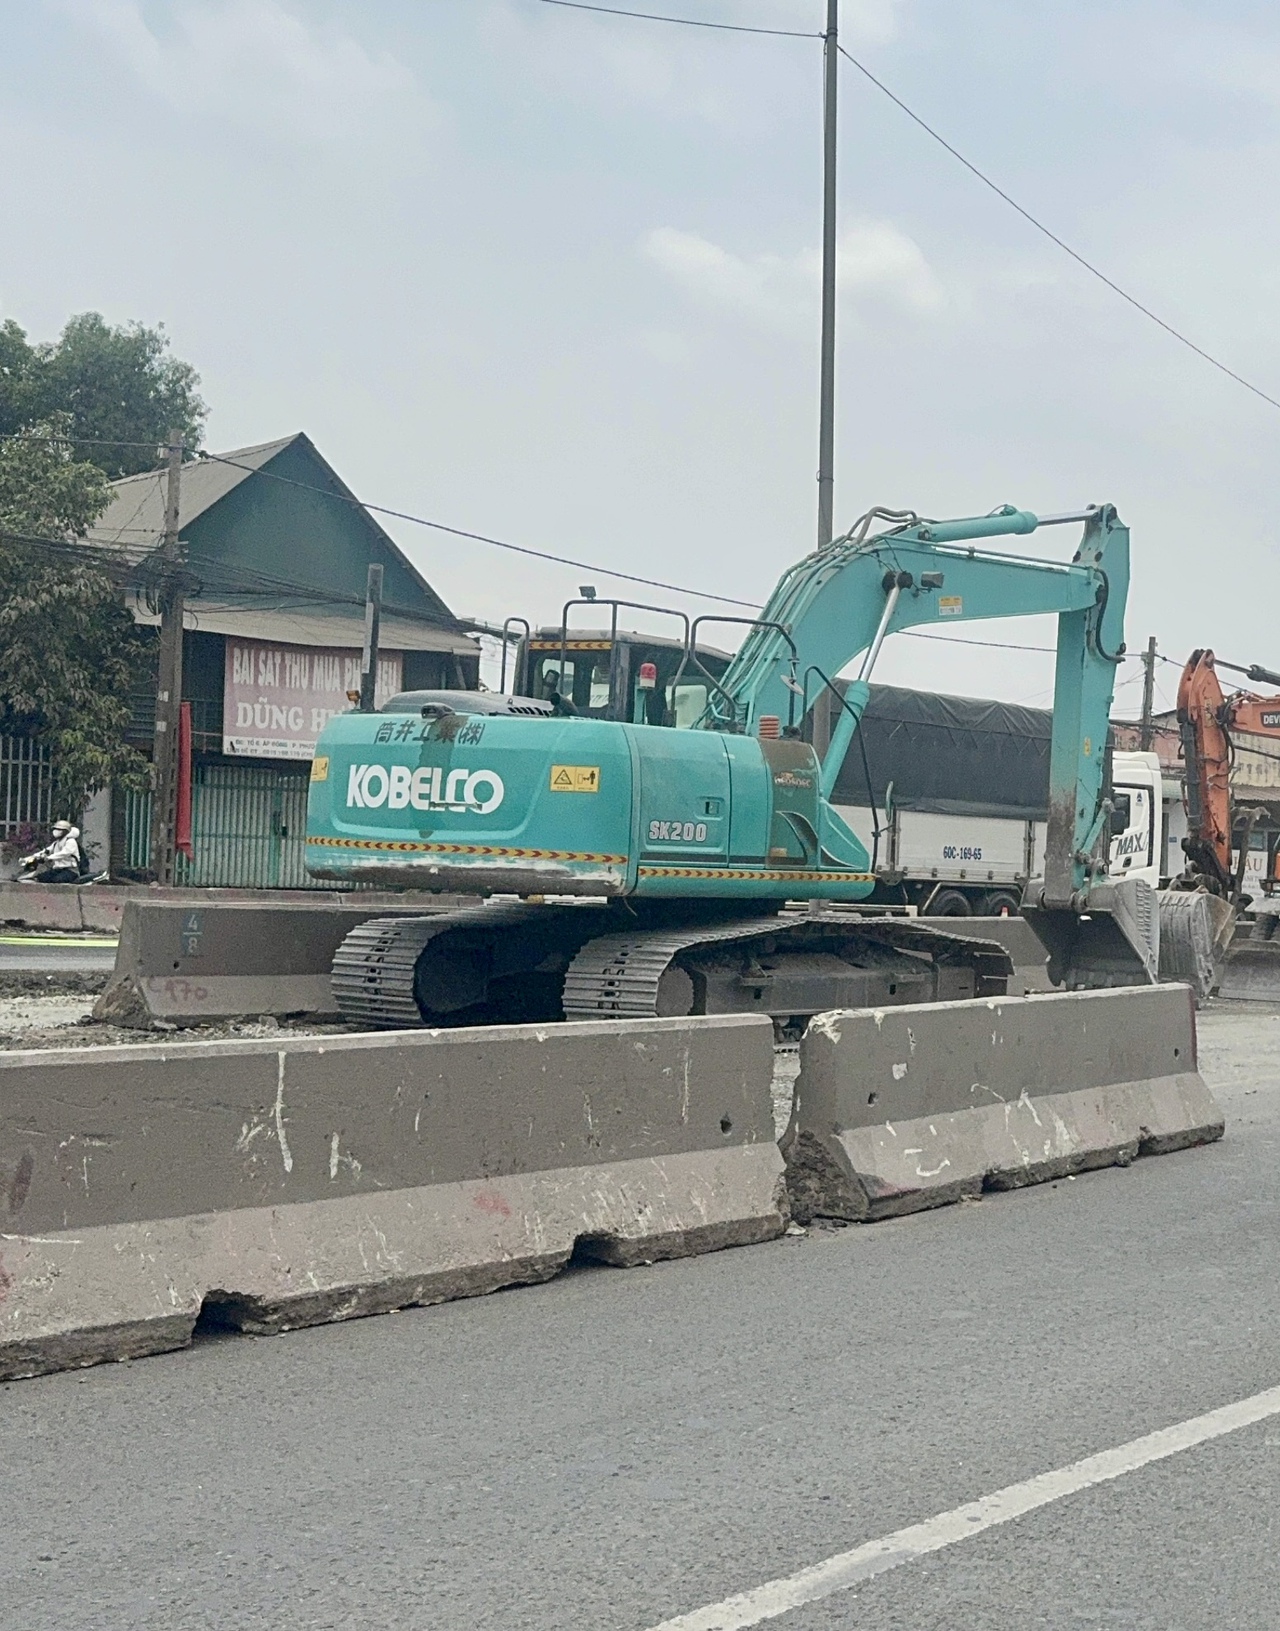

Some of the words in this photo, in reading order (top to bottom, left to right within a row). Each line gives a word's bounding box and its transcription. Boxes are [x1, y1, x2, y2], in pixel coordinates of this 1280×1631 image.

[312, 654, 341, 692] MUA
[236, 697, 304, 731] DŨNG
[346, 764, 505, 814] KOBELCO
[649, 820, 707, 842] SK200
